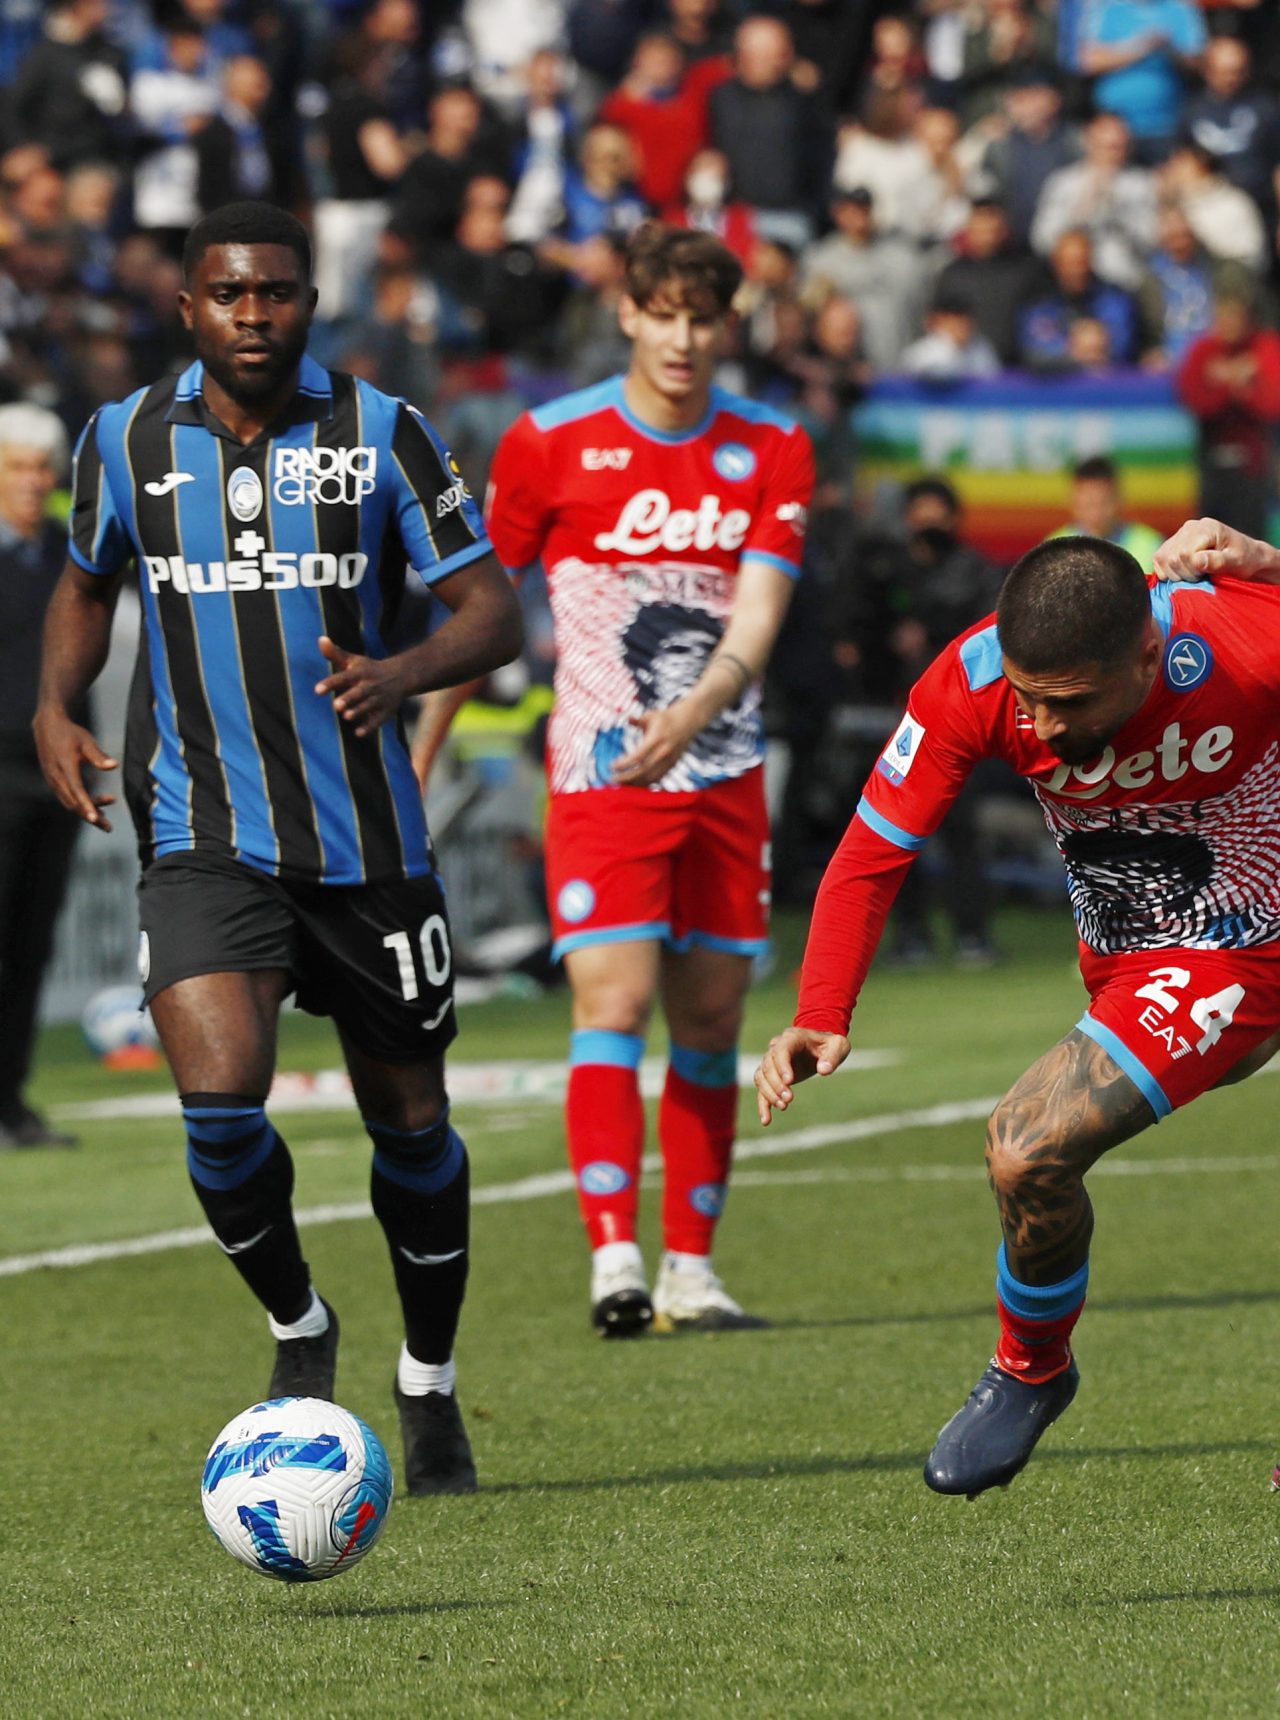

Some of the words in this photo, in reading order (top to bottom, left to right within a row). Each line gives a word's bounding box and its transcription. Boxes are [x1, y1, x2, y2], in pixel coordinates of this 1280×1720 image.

[273, 475, 376, 506] GROUP
[274, 447, 377, 478] RADICI
[594, 488, 751, 556] Lete
[144, 552, 368, 594] Plus500
[1033, 721, 1234, 800] Lete
[383, 914, 451, 1000] 10
[1134, 966, 1246, 1056] 24
[1138, 1005, 1193, 1060] EA7
